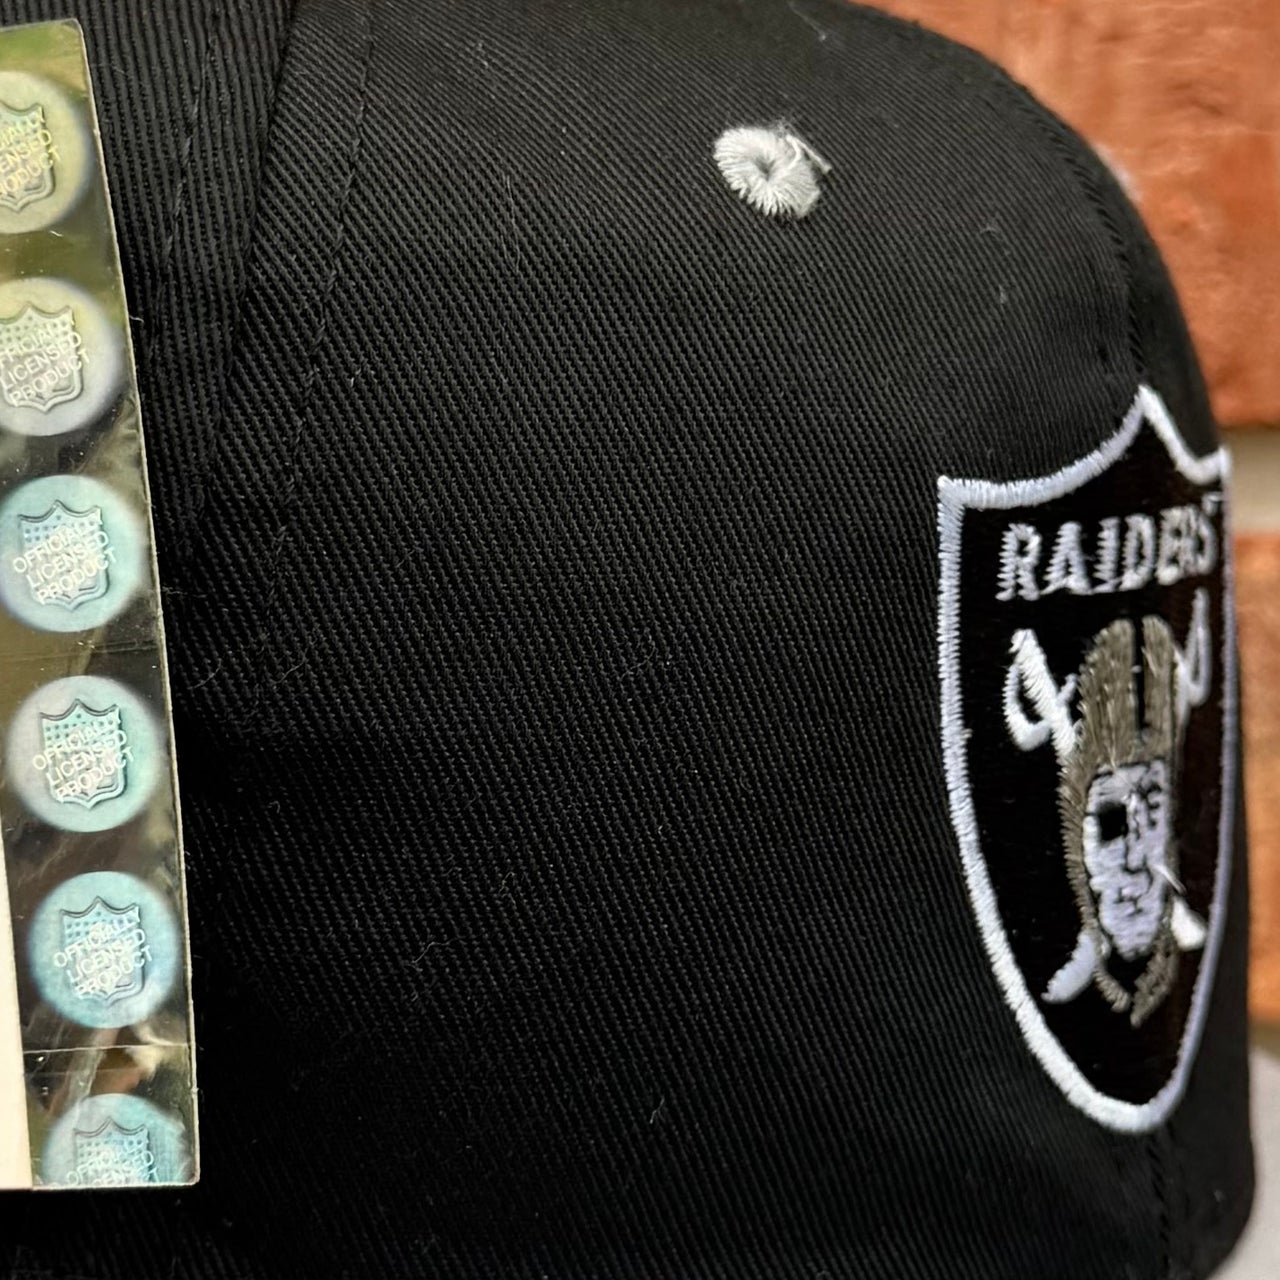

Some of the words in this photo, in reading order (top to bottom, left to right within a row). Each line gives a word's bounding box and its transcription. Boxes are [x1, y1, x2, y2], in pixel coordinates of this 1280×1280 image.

[0, 332, 81, 390] LICENSED
[9, 348, 90, 407] PRODUCT
[27, 531, 109, 588] LICENSED
[37, 546, 117, 605] PRODUCT
[46, 730, 127, 786] LICENSED
[56, 745, 134, 803] PRODUCT
[66, 929, 146, 984] LICENSED
[76, 945, 153, 999] PRODUCT
